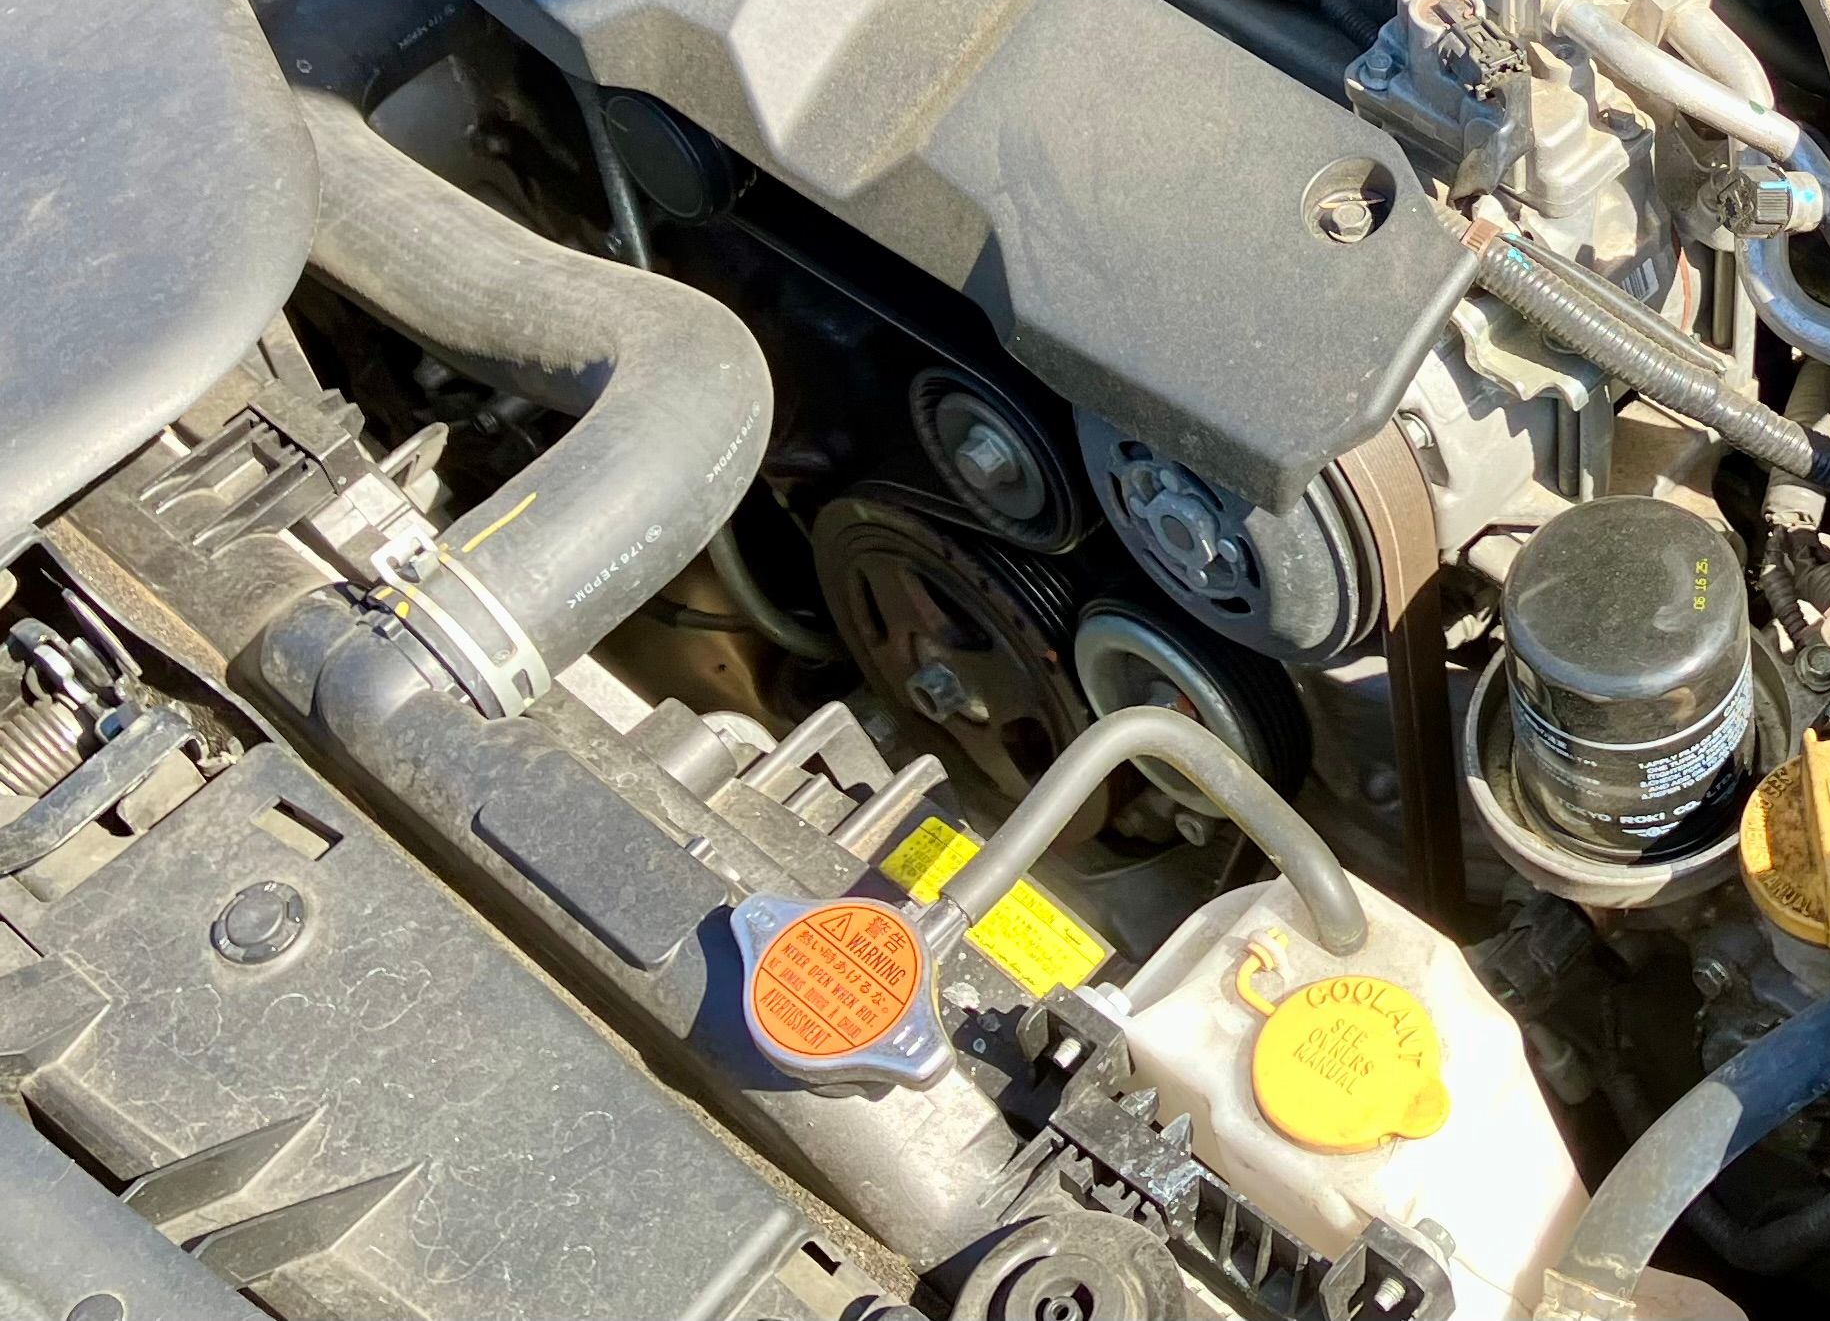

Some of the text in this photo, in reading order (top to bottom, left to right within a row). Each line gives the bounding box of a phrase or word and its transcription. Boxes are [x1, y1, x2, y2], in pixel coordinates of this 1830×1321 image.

[1619, 812, 1665, 823] ROKI
[780, 942, 878, 1028] NEVER OPEN WHEN HOT.
[844, 931, 907, 987] WARNING
[1308, 979, 1422, 1067] COOLANT
[1329, 1014, 1368, 1051] SEE
[1292, 1041, 1357, 1096] MANUAL
